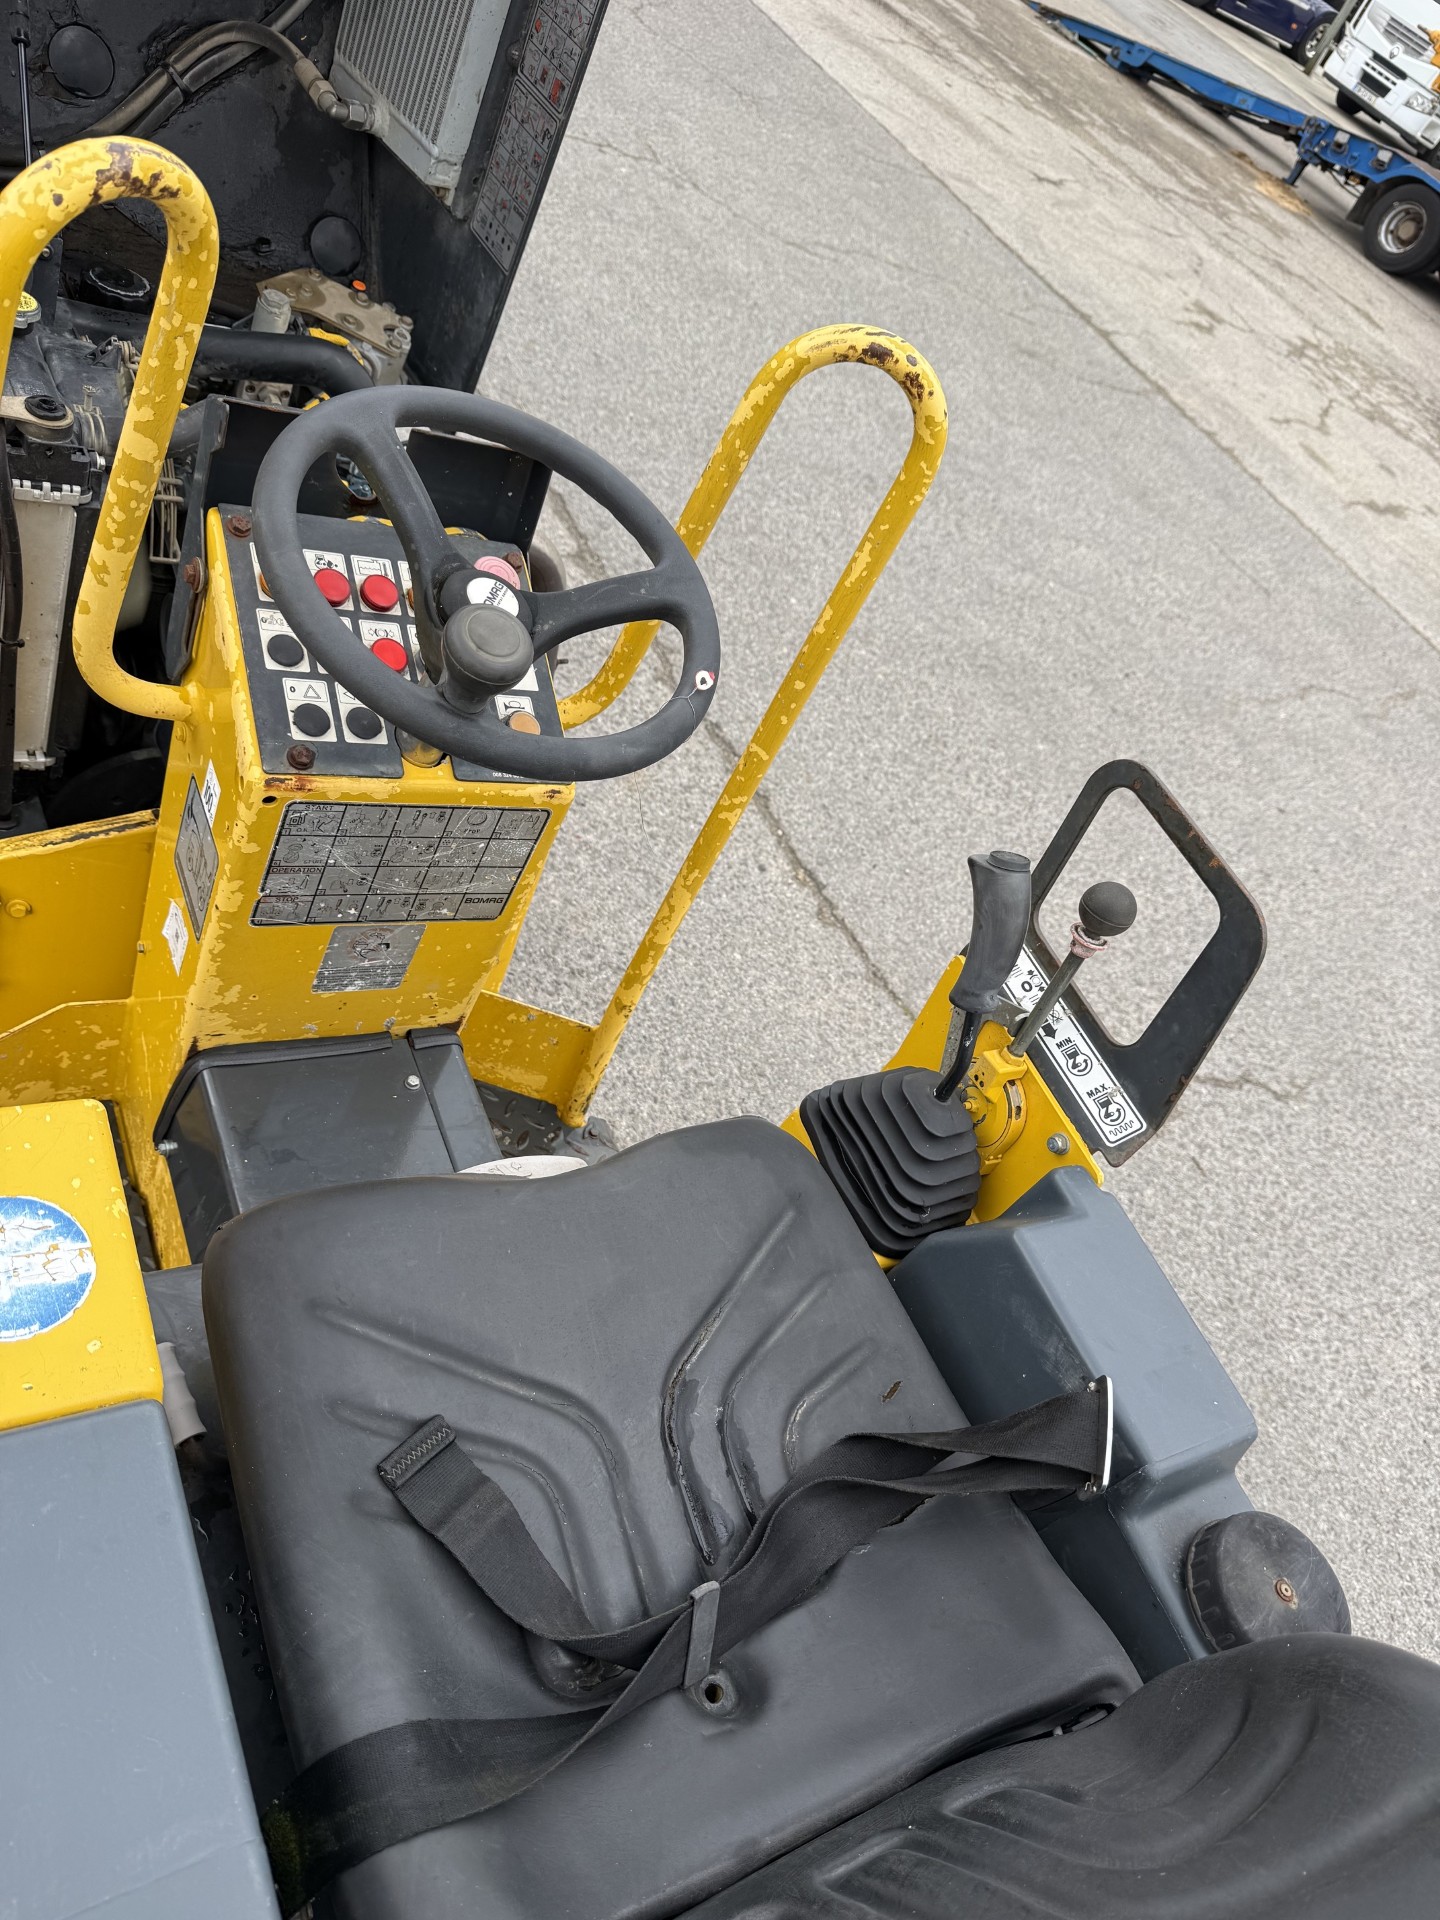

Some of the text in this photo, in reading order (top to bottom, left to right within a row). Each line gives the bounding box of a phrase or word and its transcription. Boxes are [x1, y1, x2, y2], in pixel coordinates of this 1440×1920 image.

[483, 581, 505, 605] OMAG
[1055, 1036, 1076, 1050] MIN.
[1086, 1083, 1111, 1099] MAX.
